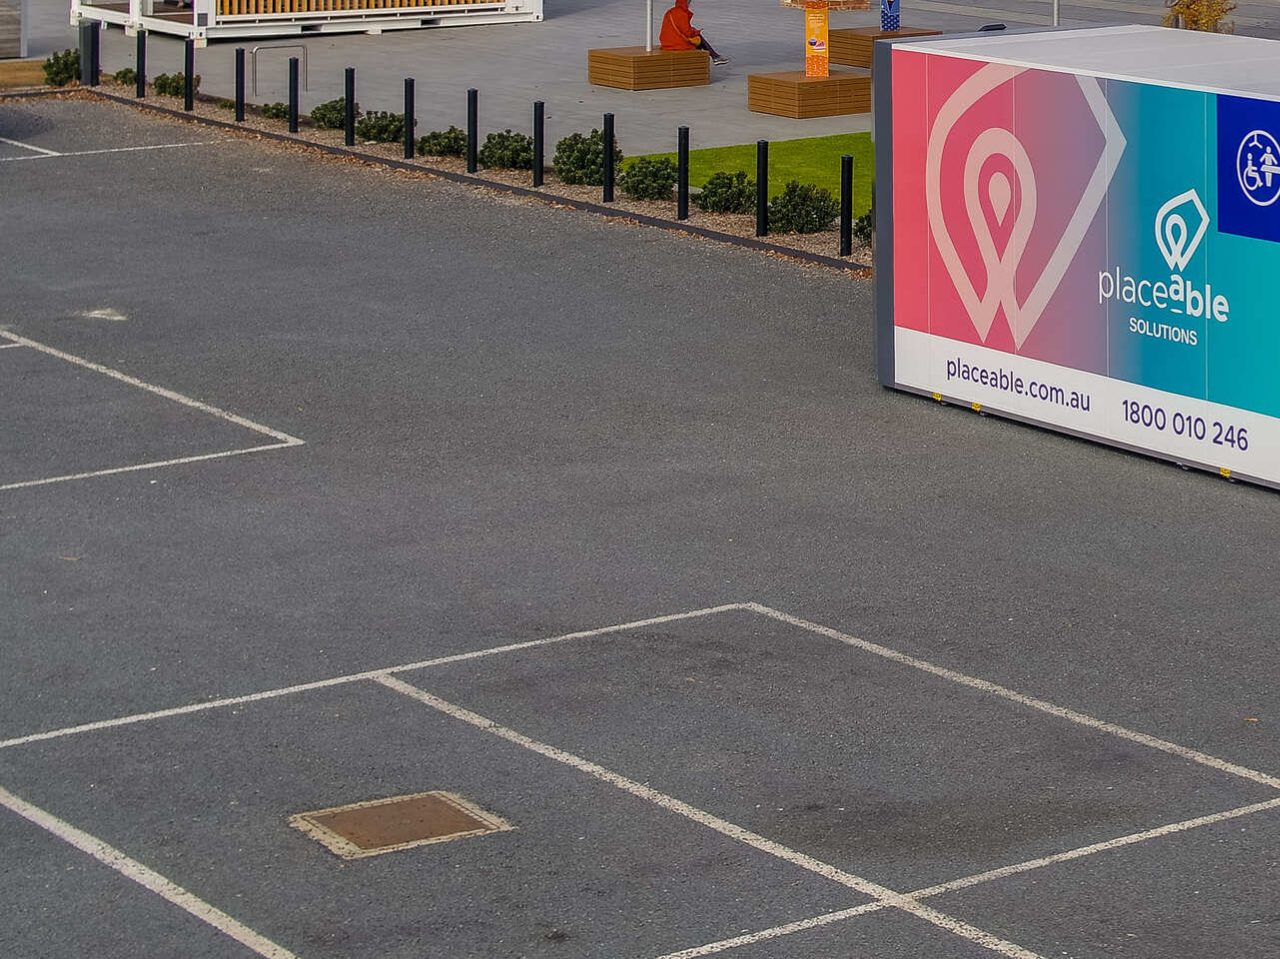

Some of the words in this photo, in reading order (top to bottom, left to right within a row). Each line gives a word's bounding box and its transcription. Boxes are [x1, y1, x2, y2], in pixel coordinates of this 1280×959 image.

[1098, 265, 1230, 323] placeable
[1129, 317, 1199, 346] SOLUTIONS
[946, 357, 1091, 412] placeable.com.au
[1122, 399, 1167, 431] 1800
[1172, 412, 1207, 441] 010
[1212, 421, 1249, 452] 246
